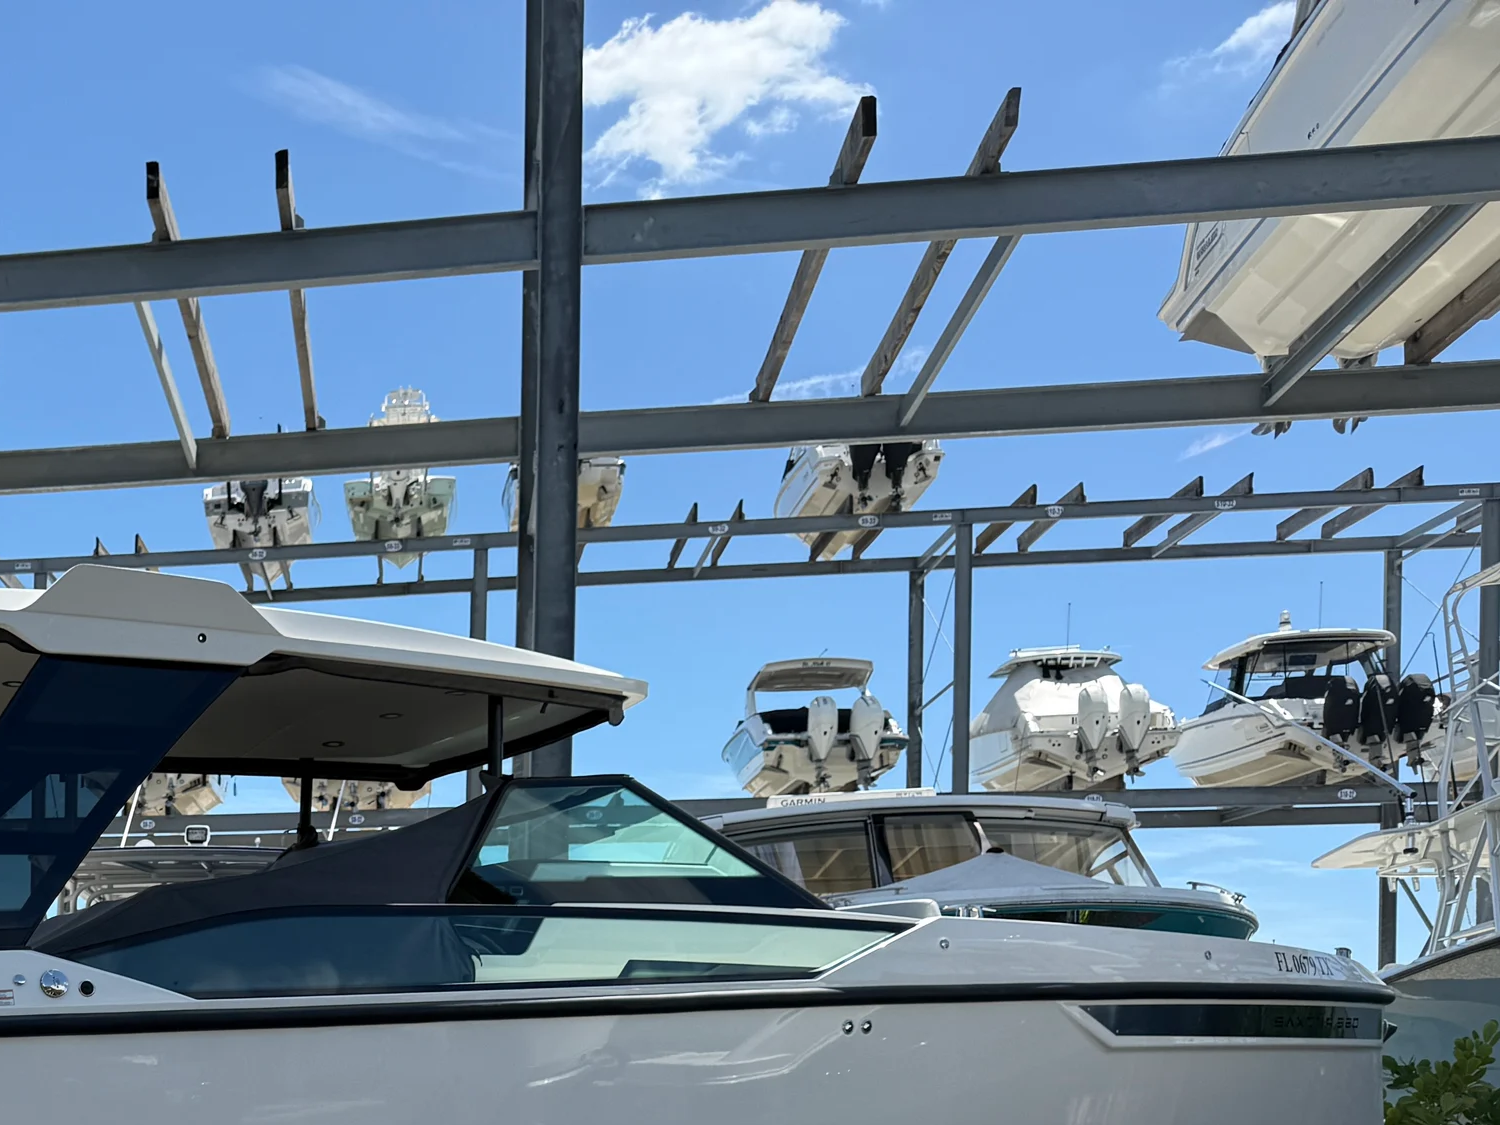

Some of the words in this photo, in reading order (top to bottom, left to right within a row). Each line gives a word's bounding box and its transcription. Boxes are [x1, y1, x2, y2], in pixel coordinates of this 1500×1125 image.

[780, 797, 826, 807] GARMIN
[1274, 952, 1293, 972] FL
[1292, 954, 1317, 976] 0679
